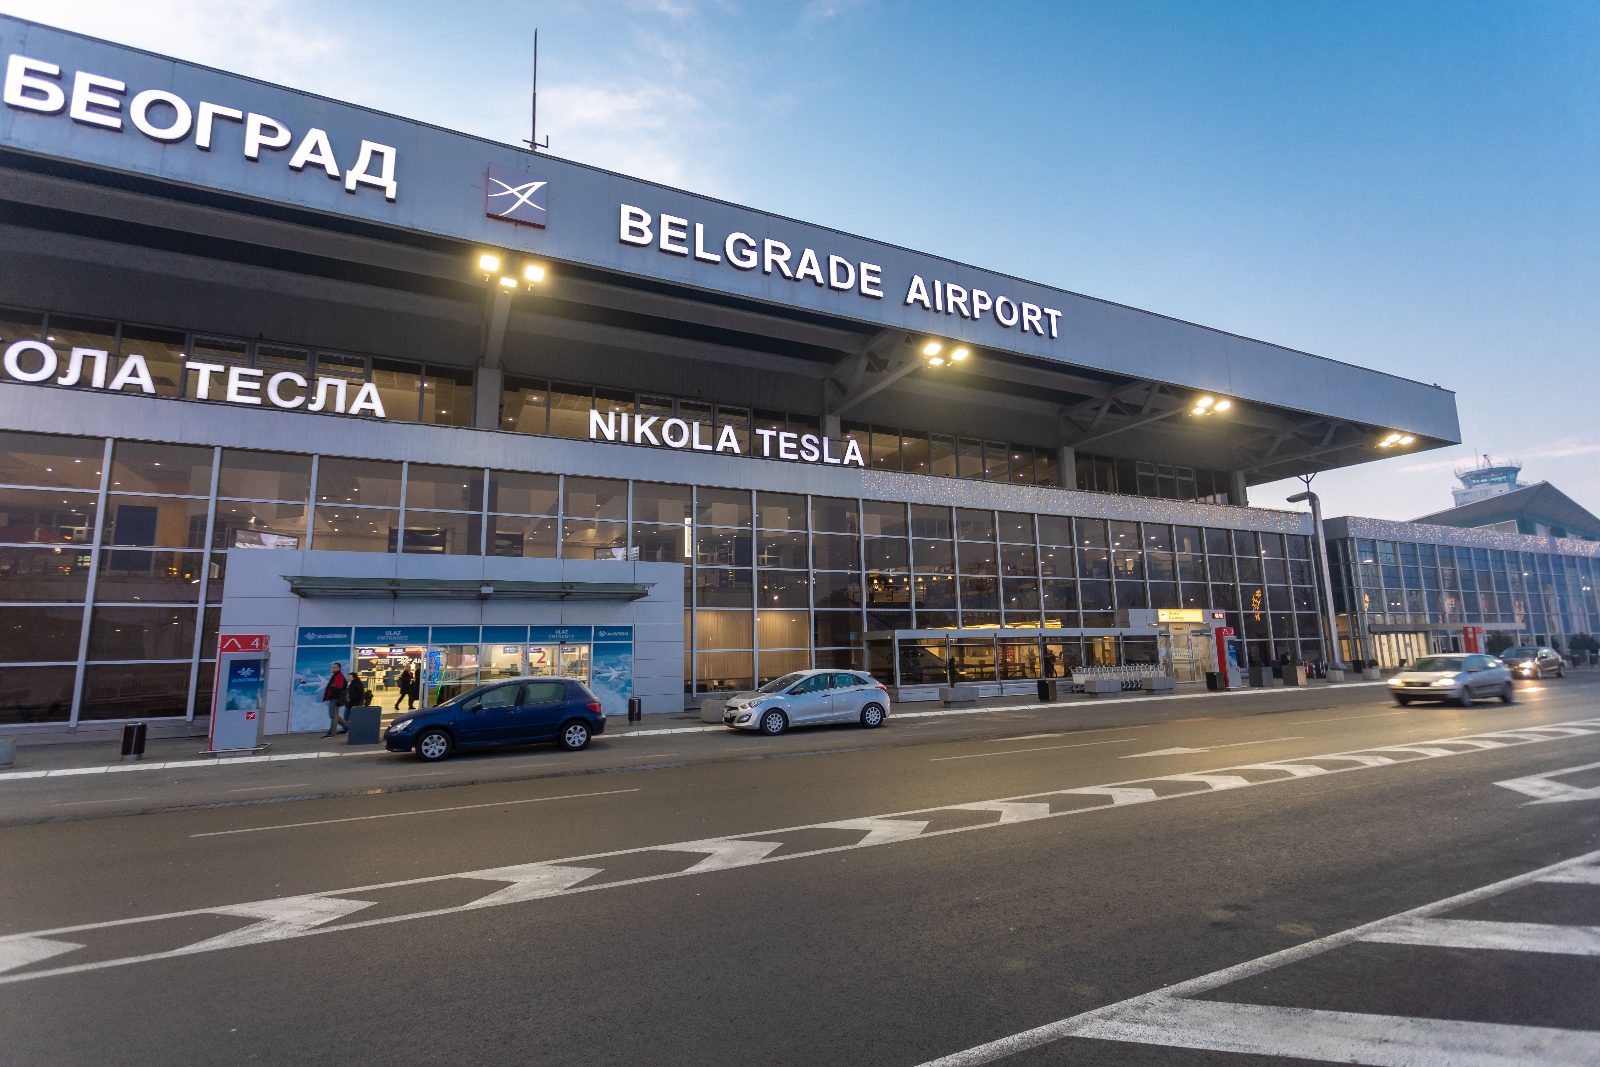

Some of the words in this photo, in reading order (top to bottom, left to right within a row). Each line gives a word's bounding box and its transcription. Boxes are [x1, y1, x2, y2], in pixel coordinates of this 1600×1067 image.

[3, 54, 398, 202] БЕОГРАД
[619, 203, 884, 300] BELGRADE
[903, 274, 1063, 340] AIRPORT
[3, 340, 156, 394] ОЛА
[185, 361, 386, 418] ТЕСЛА
[589, 409, 741, 454] NIKOLA
[755, 428, 865, 467] TESLA
